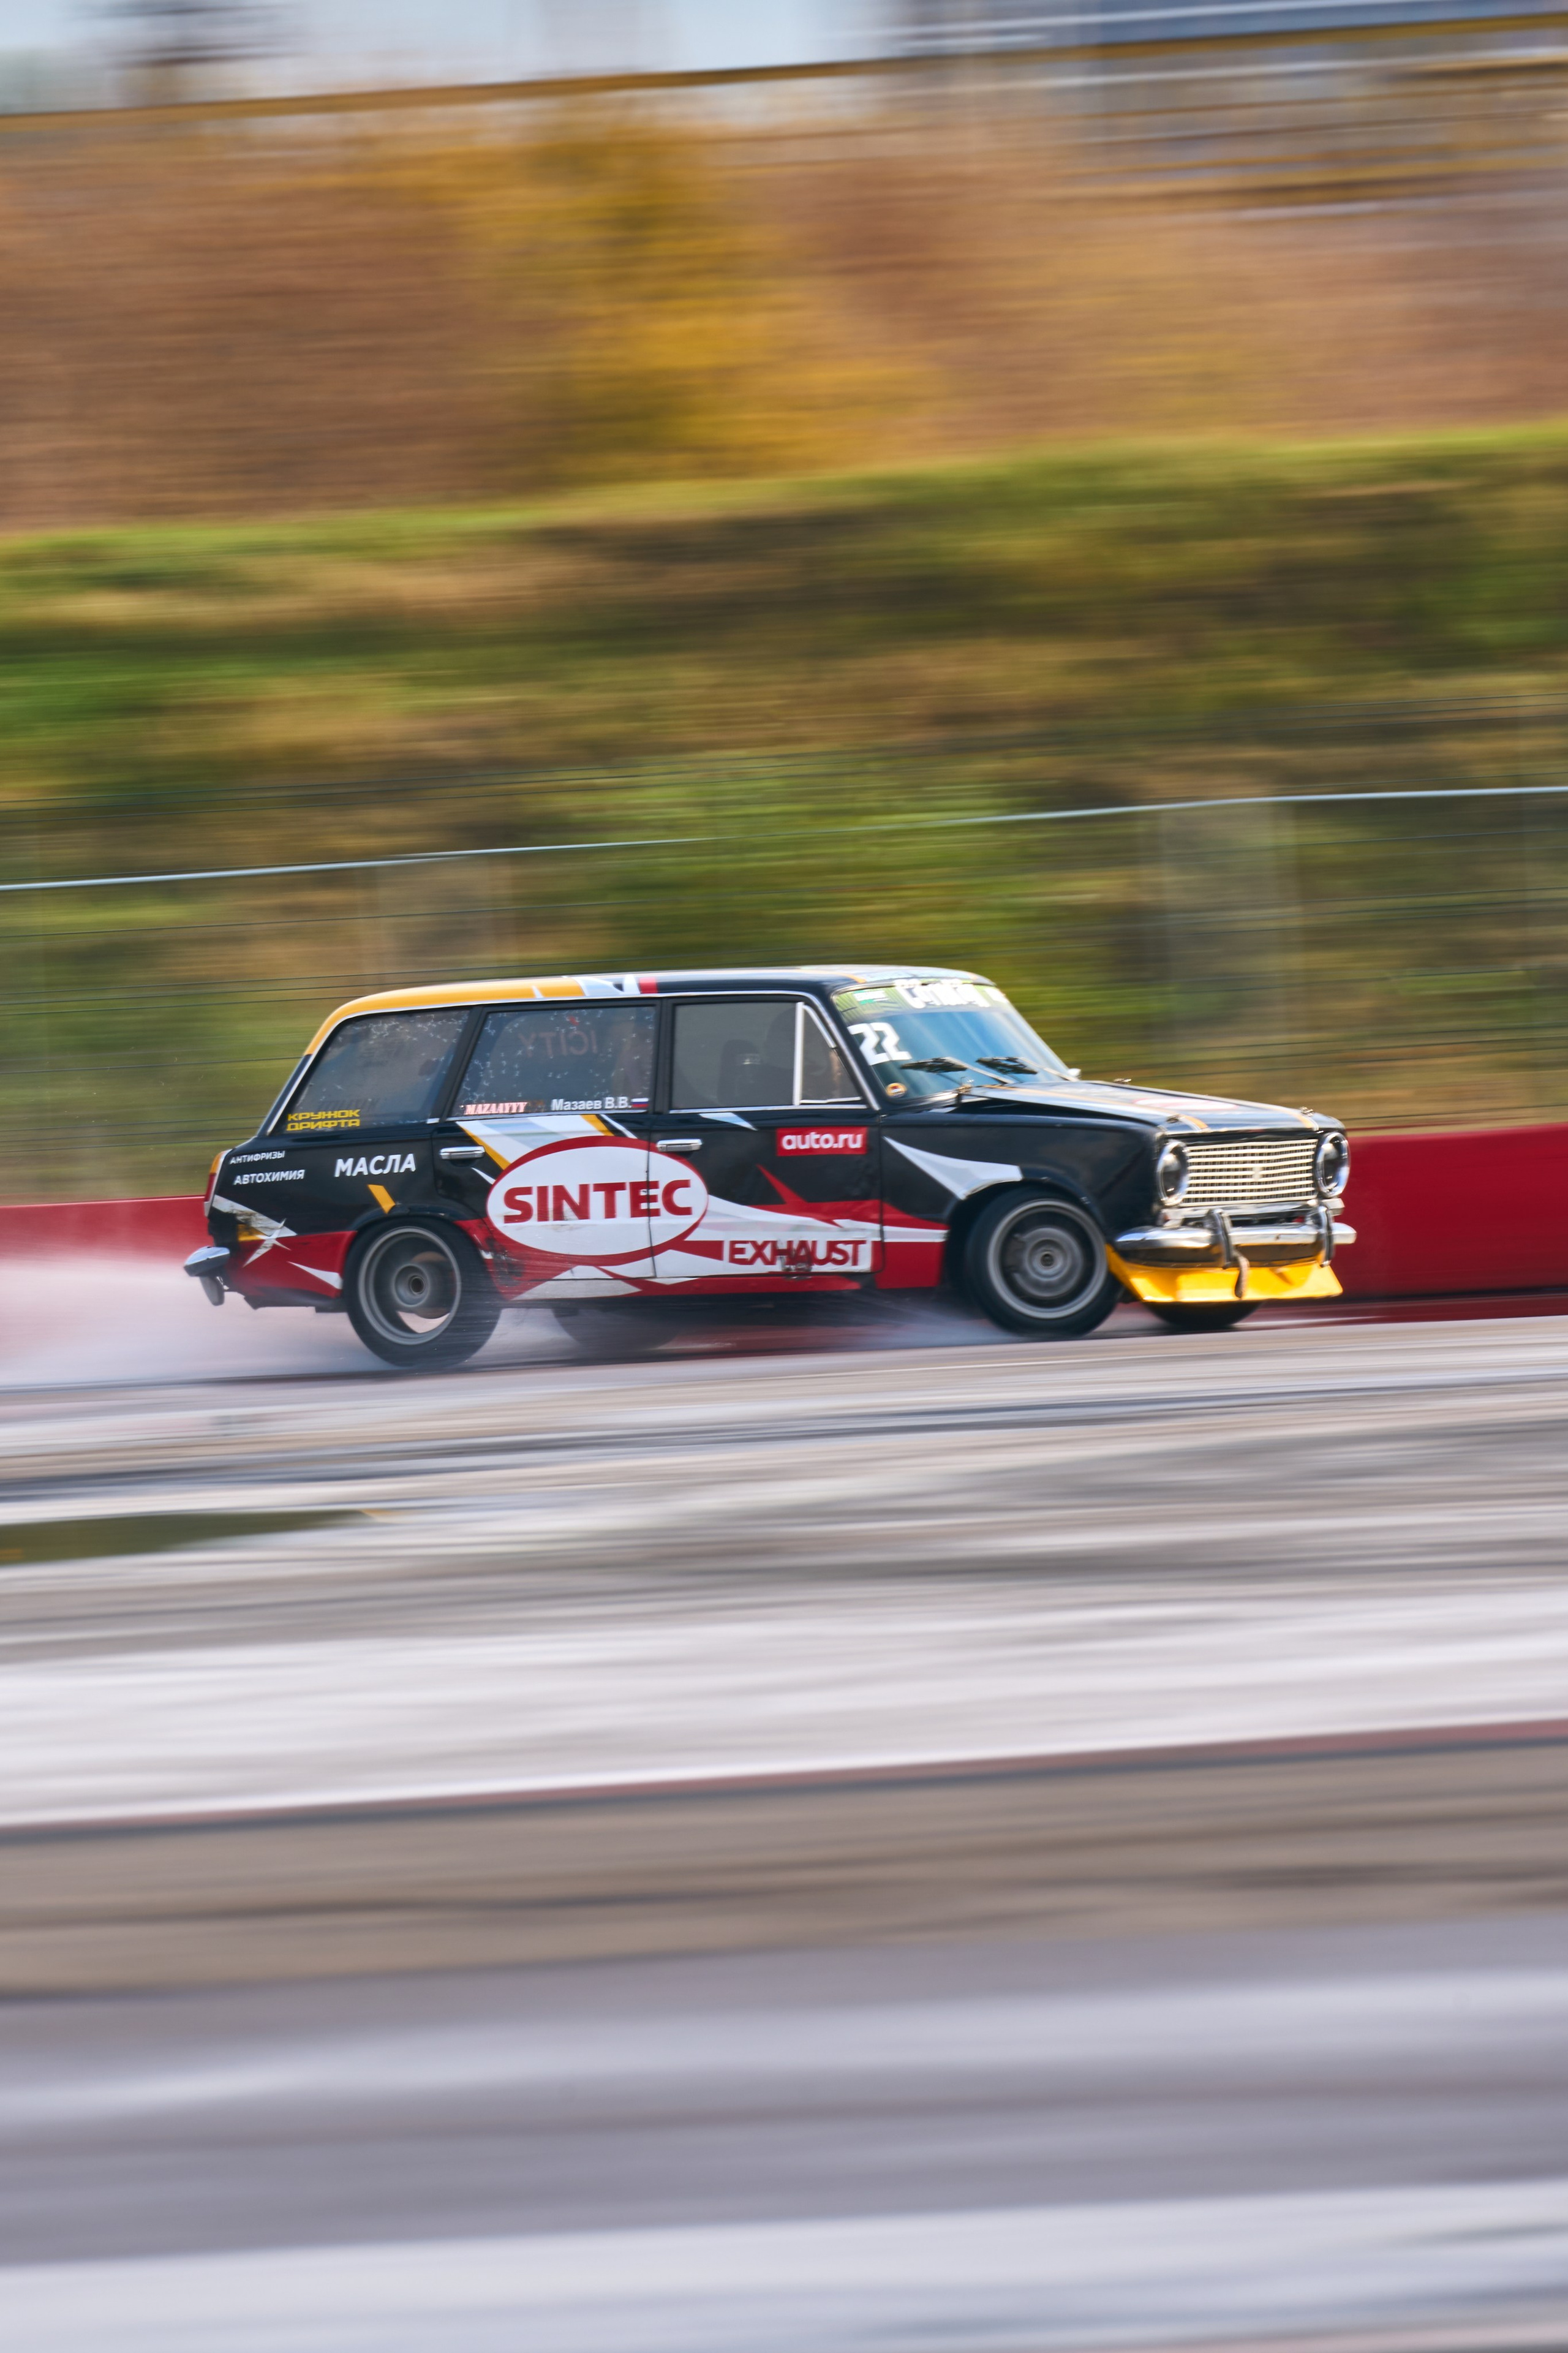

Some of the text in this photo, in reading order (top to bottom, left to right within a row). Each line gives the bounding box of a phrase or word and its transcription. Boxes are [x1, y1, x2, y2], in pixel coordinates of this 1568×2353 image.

[846, 1022, 912, 1065] 22
[552, 1097, 631, 1111] Мазаев В.В.
[288, 1109, 360, 1120] КРУЖОК
[286, 1119, 360, 1131] ДРИФТА
[782, 1132, 862, 1150] auto.ru
[230, 1150, 286, 1165] АНТИФРИЗЫ
[334, 1154, 417, 1177] МАСЛА
[233, 1169, 305, 1185] АВТОХИМИЯ
[503, 1179, 693, 1223] SINTEC
[729, 1240, 867, 1266] EXHAUST
